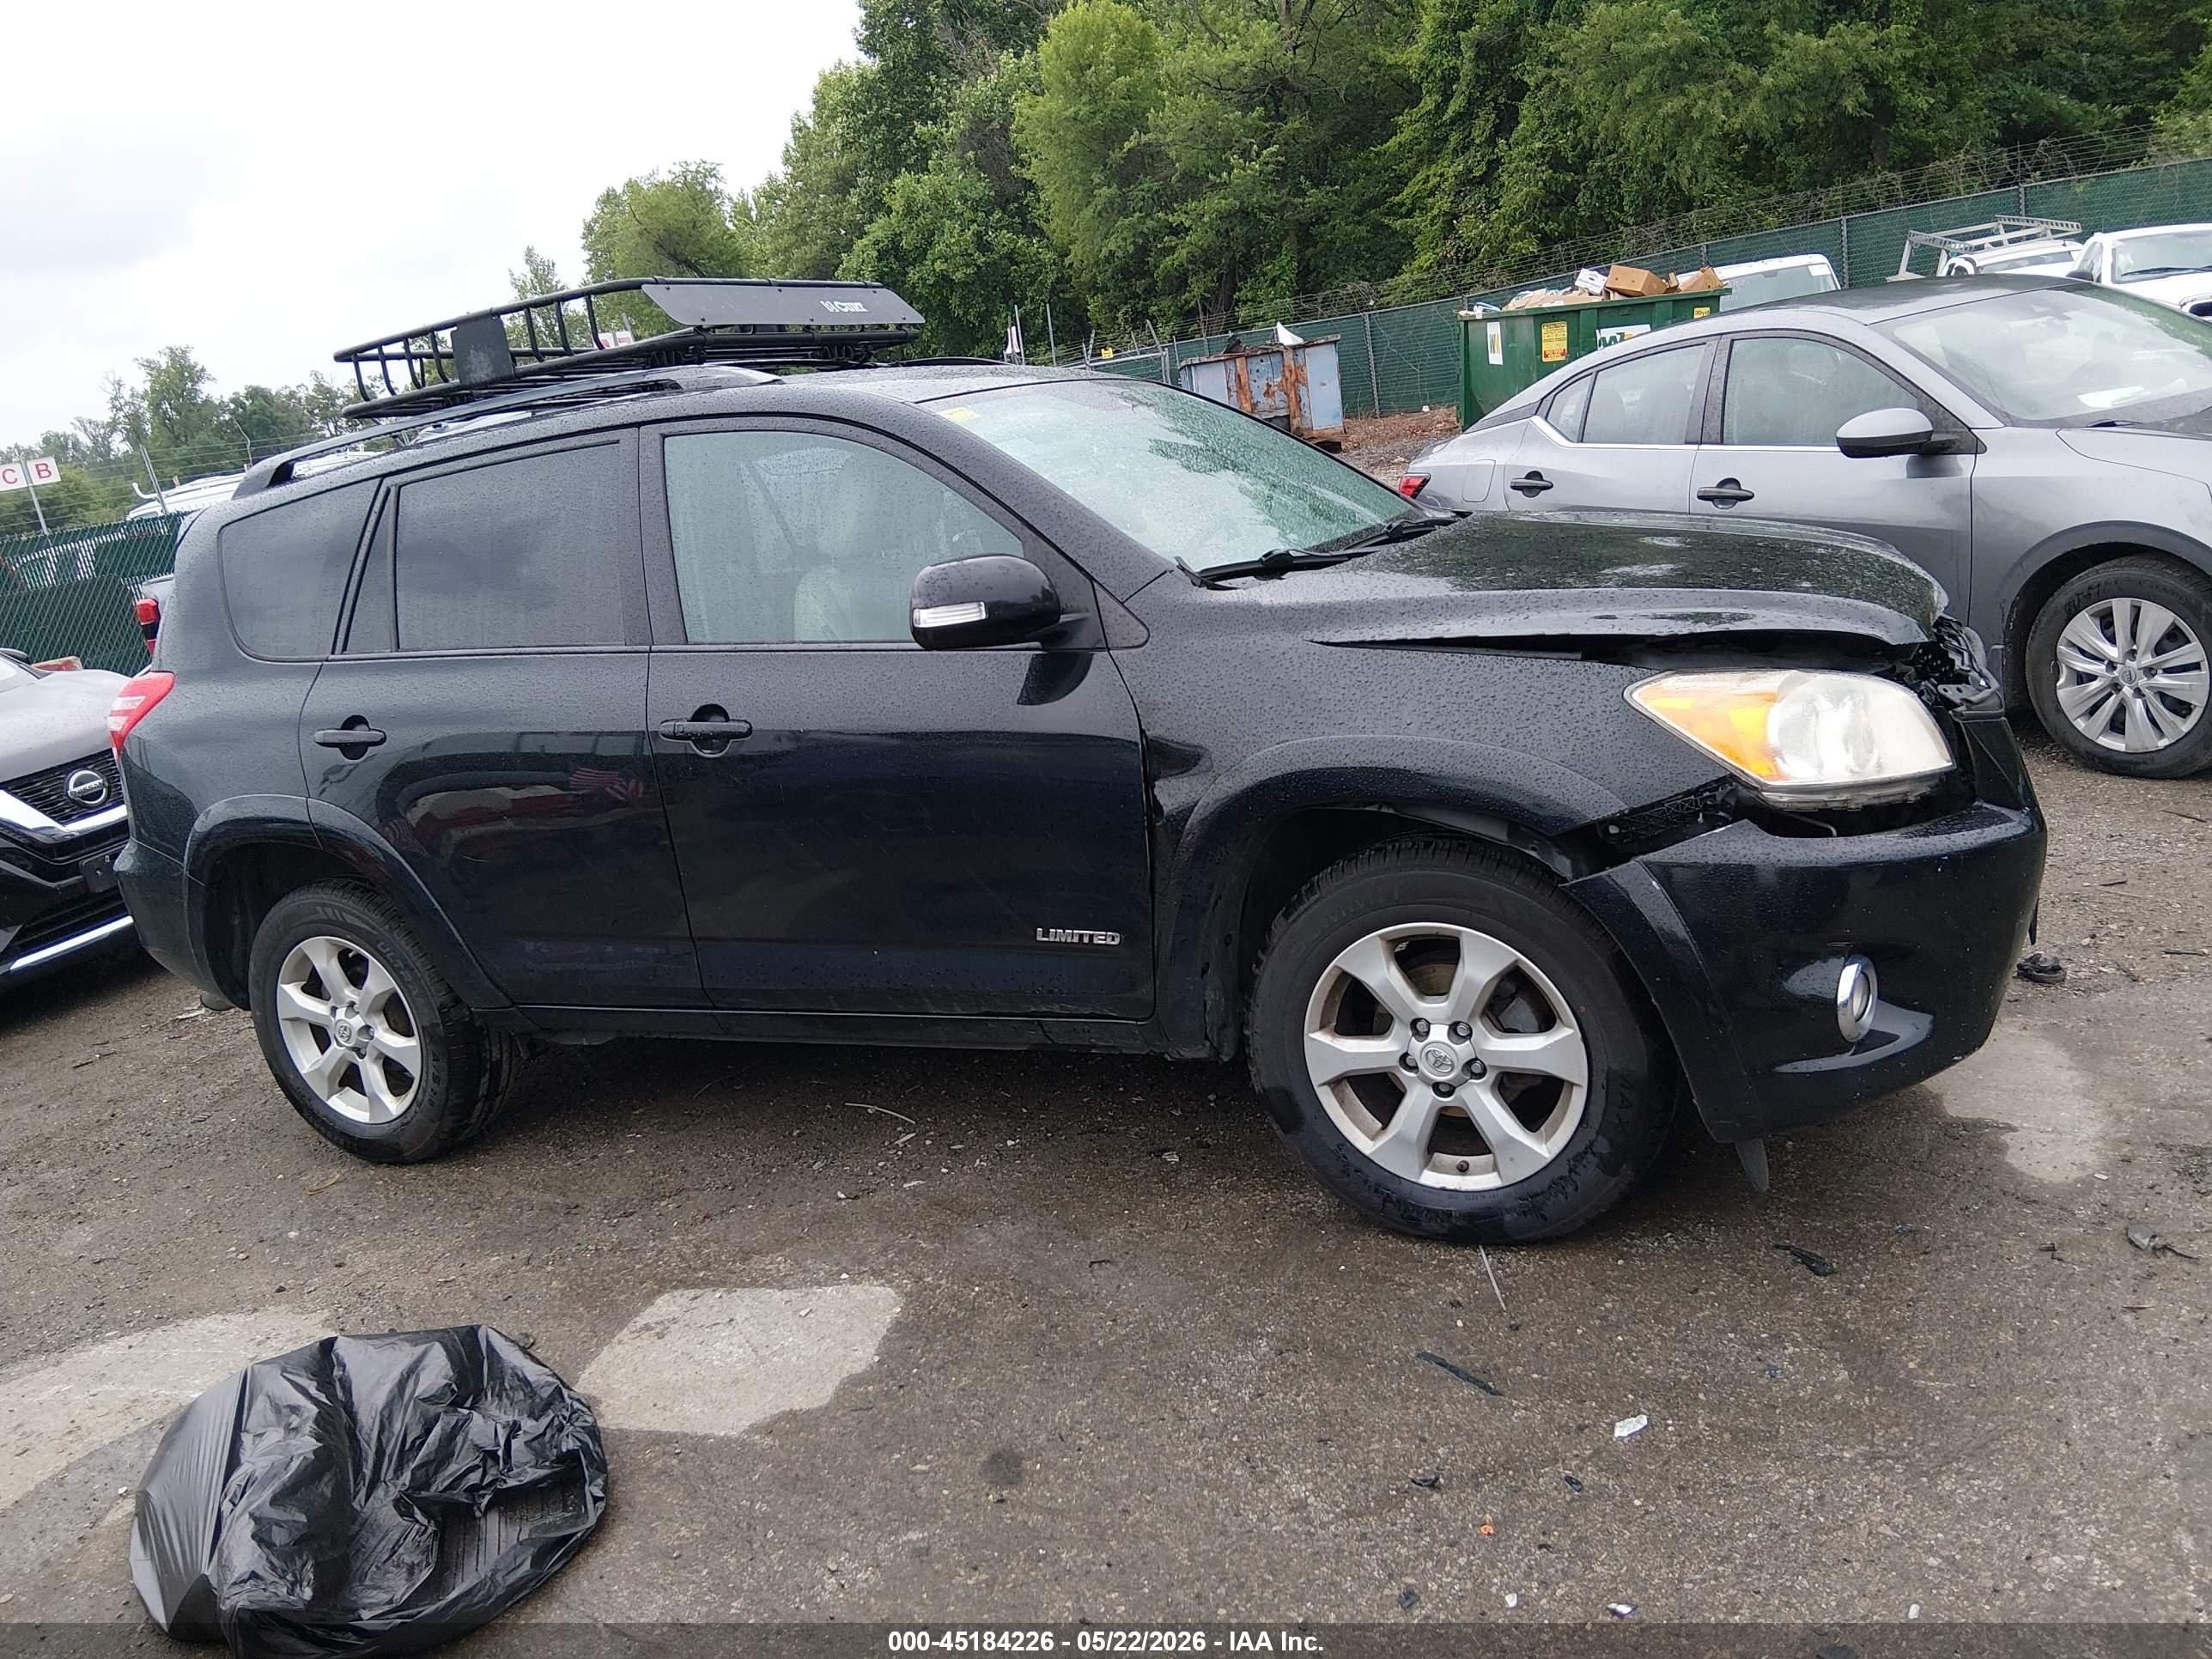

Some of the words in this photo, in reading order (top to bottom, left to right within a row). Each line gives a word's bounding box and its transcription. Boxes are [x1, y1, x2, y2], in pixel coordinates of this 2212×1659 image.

[2, 468, 18, 484] C
[34, 462, 52, 479] B
[76, 779, 104, 796] NISSAN
[1036, 927, 1121, 945] LIMITED
